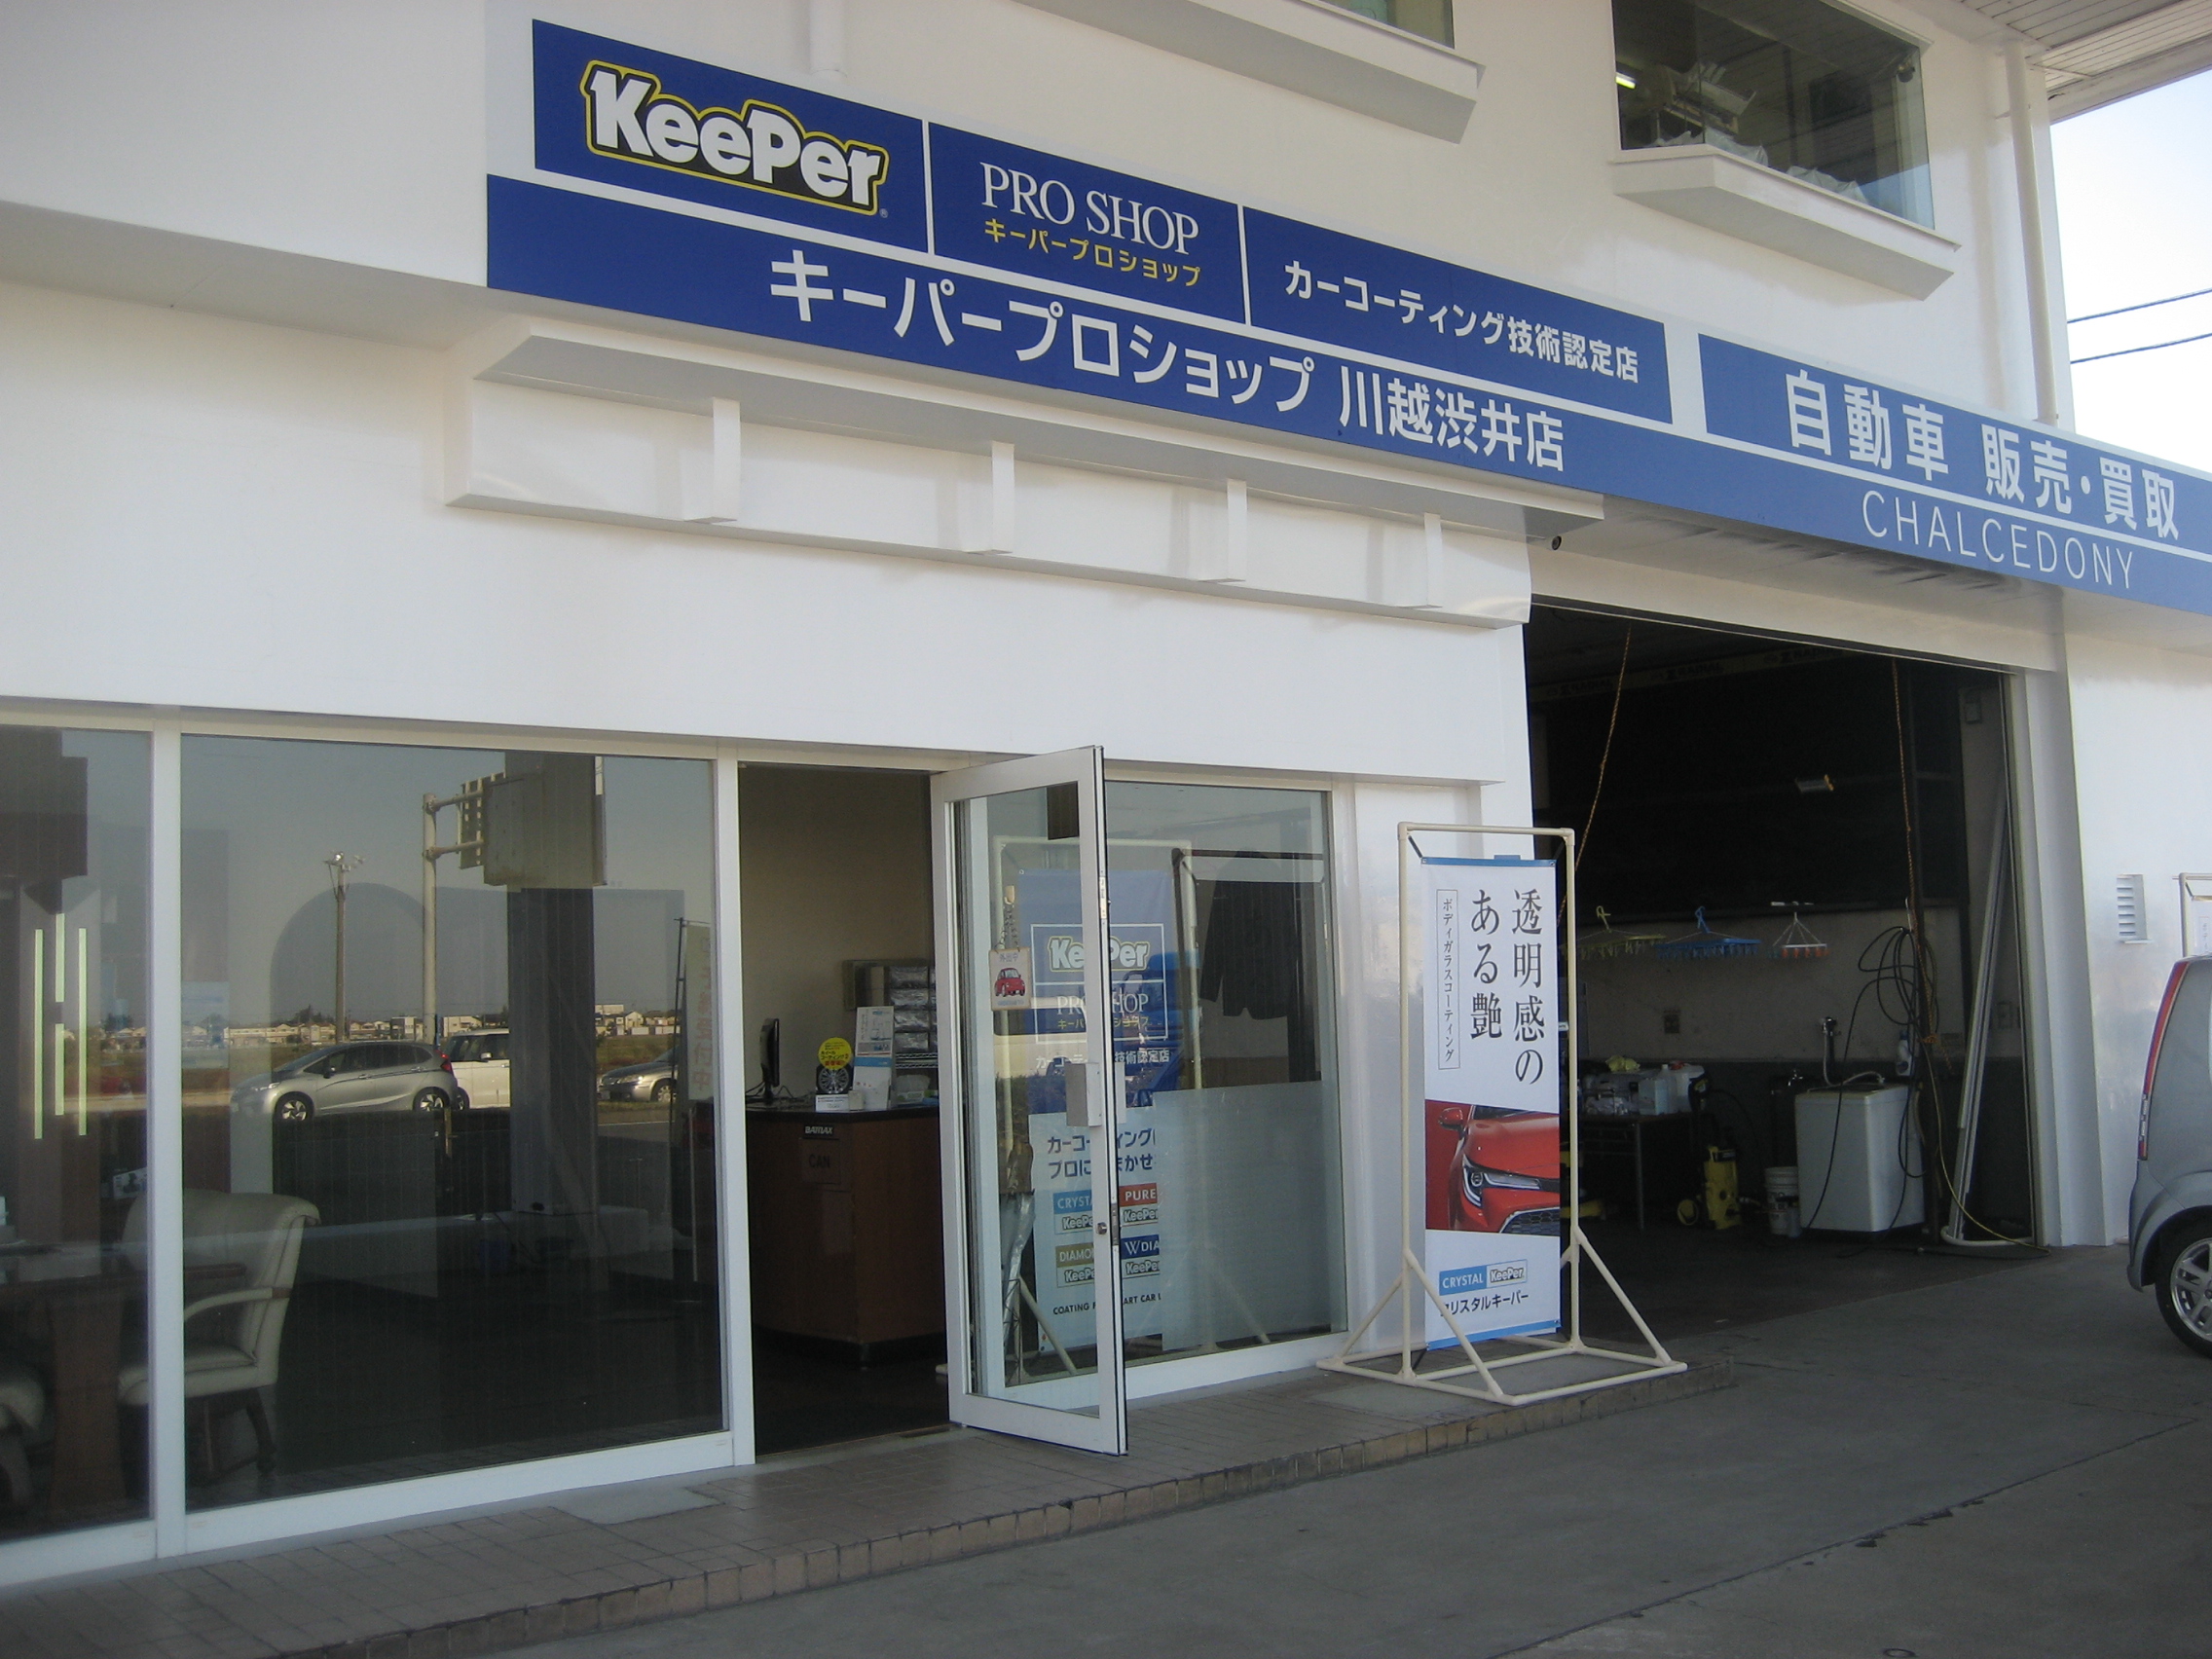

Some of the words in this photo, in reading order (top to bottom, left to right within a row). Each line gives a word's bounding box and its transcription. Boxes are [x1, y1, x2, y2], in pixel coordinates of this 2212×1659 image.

[586, 65, 884, 210] KeePer
[980, 162, 1075, 225] PRO
[1086, 190, 1199, 255] SHOP
[983, 217, 1201, 286] キーパープロショップ
[770, 249, 1315, 413] キーパープロショップ
[1339, 365, 1565, 471] 川越渋井店
[1284, 260, 1640, 384] カーコーティング技術認定店
[1786, 369, 1948, 481] 自動車
[1981, 424, 2179, 540] 販売・買取
[1862, 490, 2133, 589] CHALCEDONY
[1050, 937, 1149, 971] KePer
[1442, 898, 1455, 1062] ボディガラスコーティング
[1470, 889, 1503, 1040] ある艶
[1511, 888, 1545, 1085] 透明感の
[1112, 993, 1149, 1014] HOP
[1057, 1196, 1091, 1209] CRYST
[1124, 1188, 1157, 1201] PURE
[1059, 1248, 1094, 1263] DIAMO
[1442, 1272, 1484, 1289] CRYSTAL
[1490, 1266, 1525, 1283] KeePer
[1052, 1303, 1089, 1315] COATING
[1140, 1294, 1156, 1303] CAR
